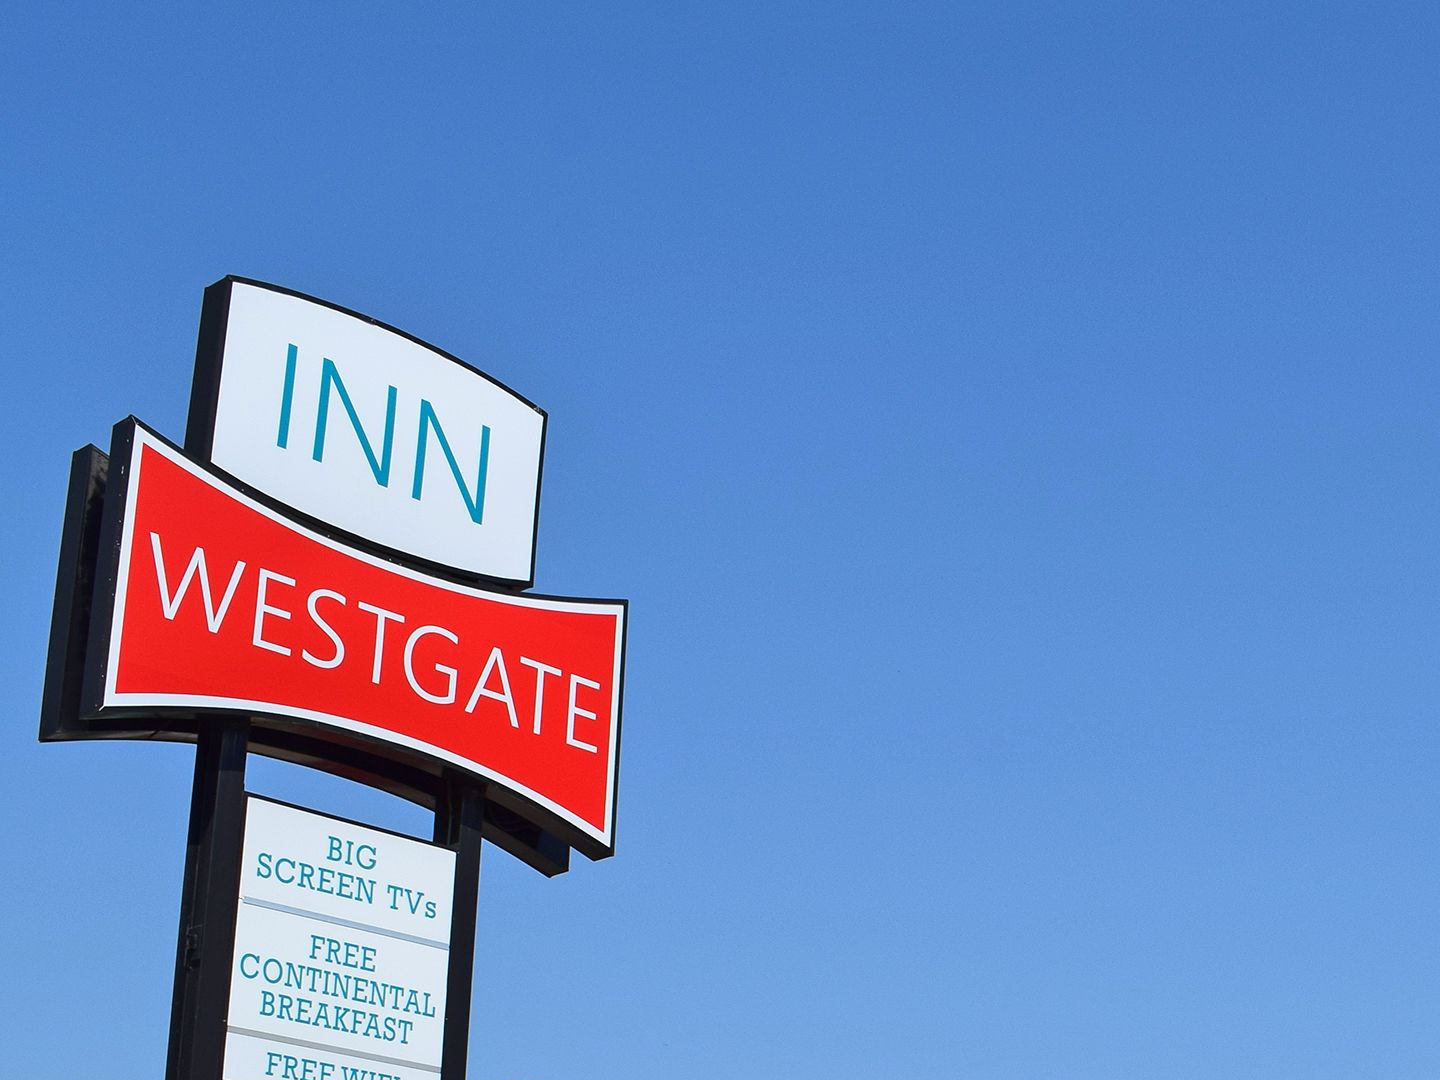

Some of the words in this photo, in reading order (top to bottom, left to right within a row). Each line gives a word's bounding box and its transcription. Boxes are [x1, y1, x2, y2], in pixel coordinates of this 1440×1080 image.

[277, 343, 491, 525] INN
[150, 531, 601, 754] WESTGATE
[326, 835, 377, 870] BIG
[257, 852, 376, 904] SCREEN
[387, 885, 437, 919] TVs
[240, 953, 436, 1018] CONTINENTAL
[309, 934, 377, 972] FREE
[259, 990, 413, 1044] BREAKFAST
